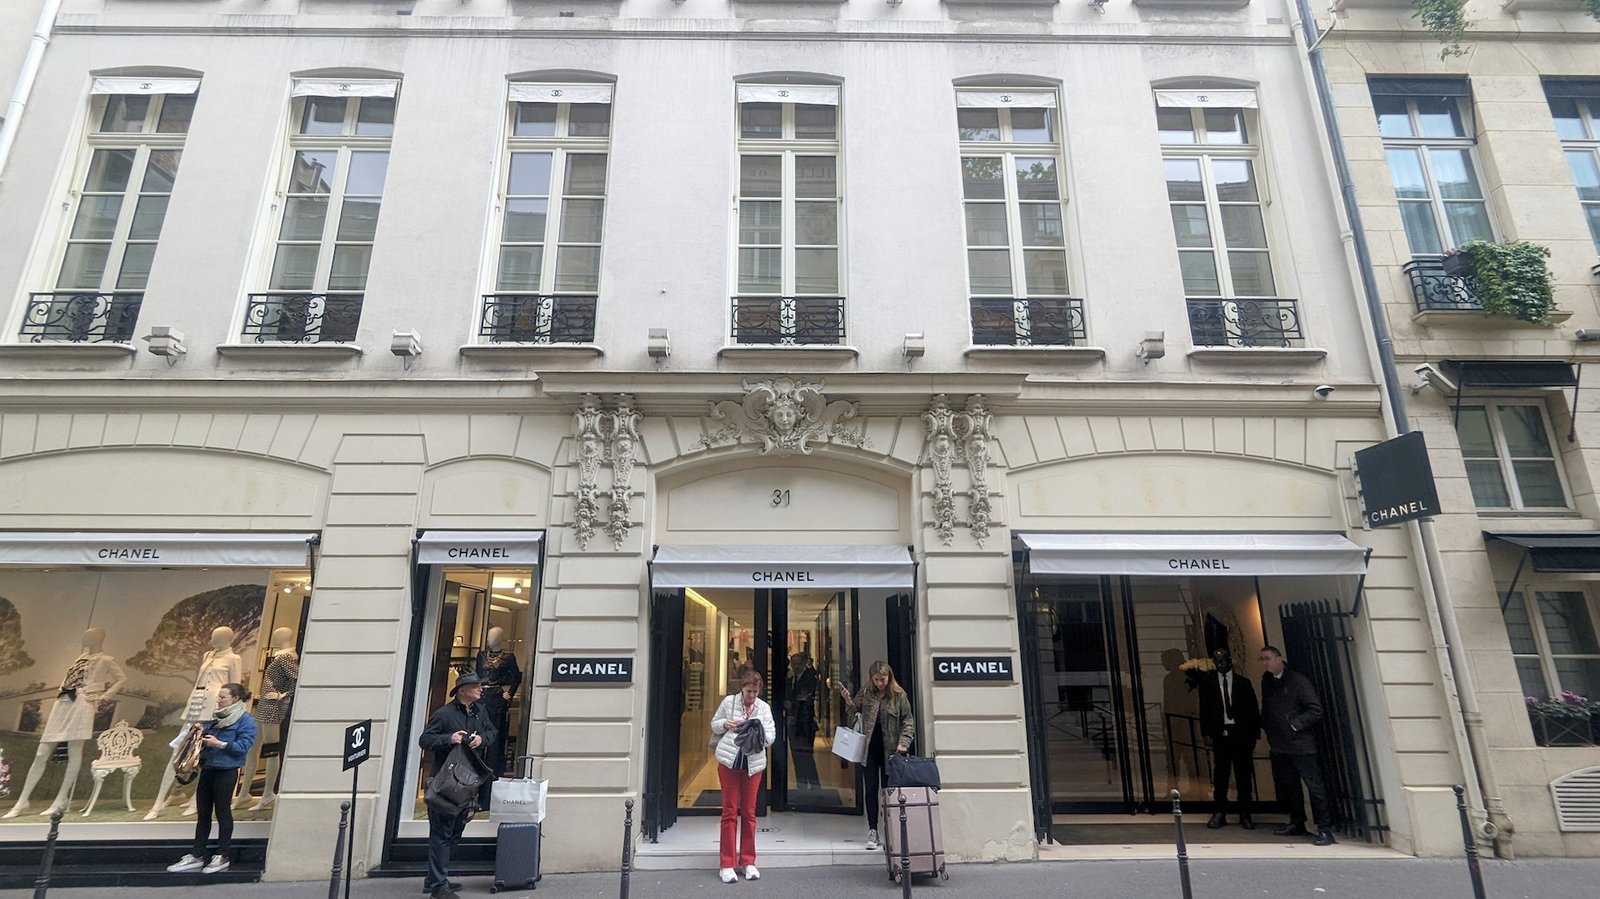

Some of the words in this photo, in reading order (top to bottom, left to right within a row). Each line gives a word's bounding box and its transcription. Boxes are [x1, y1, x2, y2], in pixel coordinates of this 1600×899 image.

[773, 489, 790, 506] 31
[1371, 501, 1427, 522] CHANEL
[98, 549, 160, 559] CHANEL
[448, 548, 509, 559] CHANEL
[1168, 558, 1230, 570] CHANEL
[752, 571, 815, 582] CHANEL
[557, 662, 627, 675] CHANEL
[938, 662, 1008, 674] CHANEL
